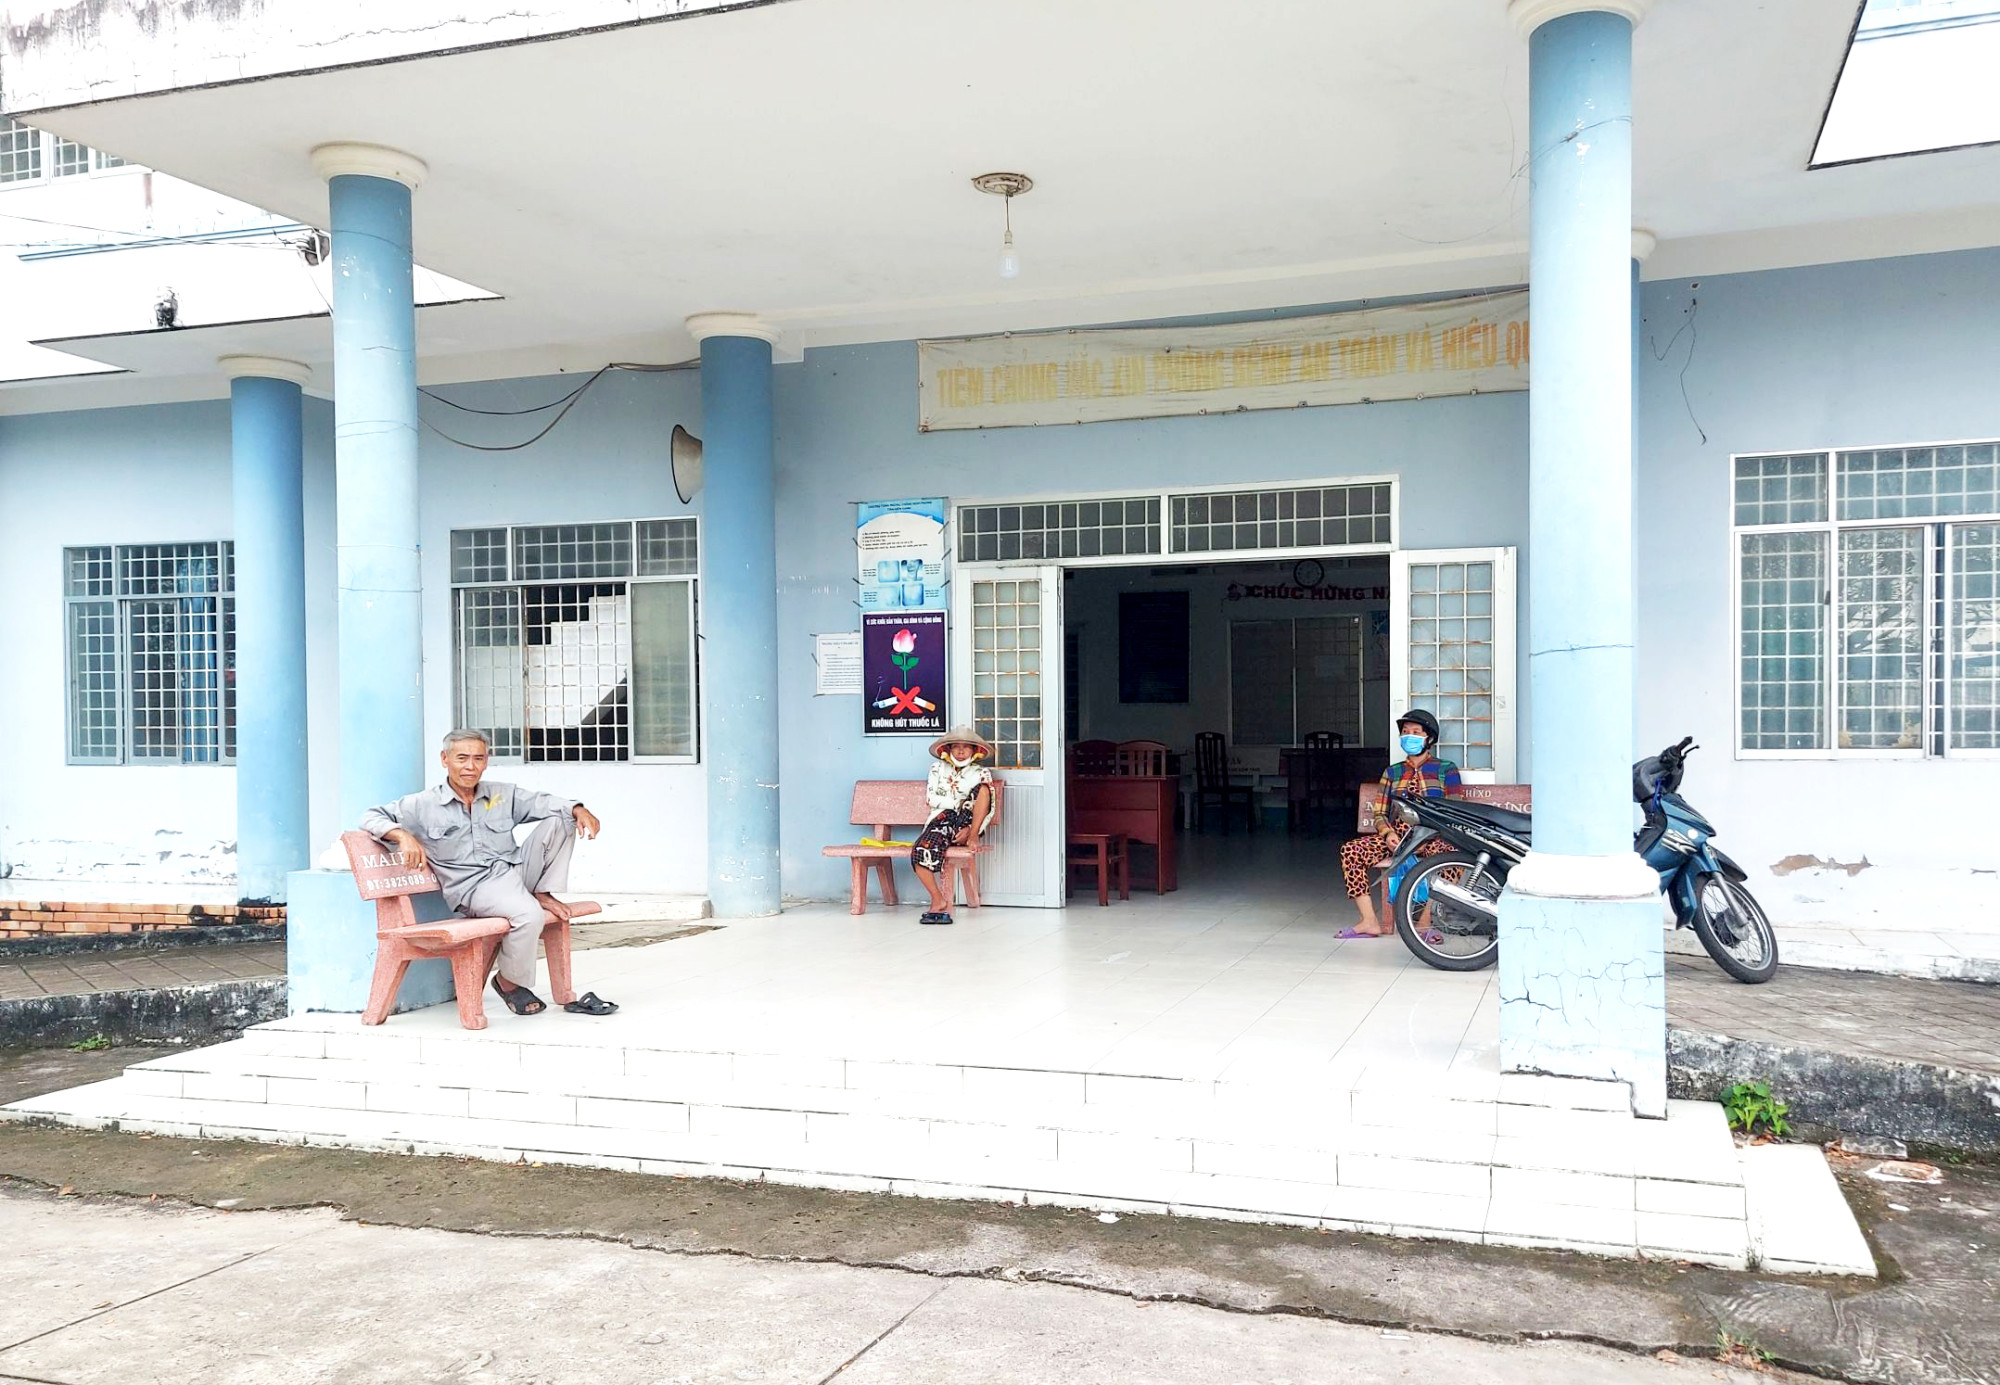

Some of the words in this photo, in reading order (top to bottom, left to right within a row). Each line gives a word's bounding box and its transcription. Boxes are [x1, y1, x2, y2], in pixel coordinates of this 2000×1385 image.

[1299, 341, 1331, 382] AN
[1405, 322, 1433, 374] VÀ
[871, 717, 893, 728] KHÔNG
[895, 716, 907, 728] HÚT
[908, 715, 930, 727] THUỐC
[931, 716, 940, 727] LÁ
